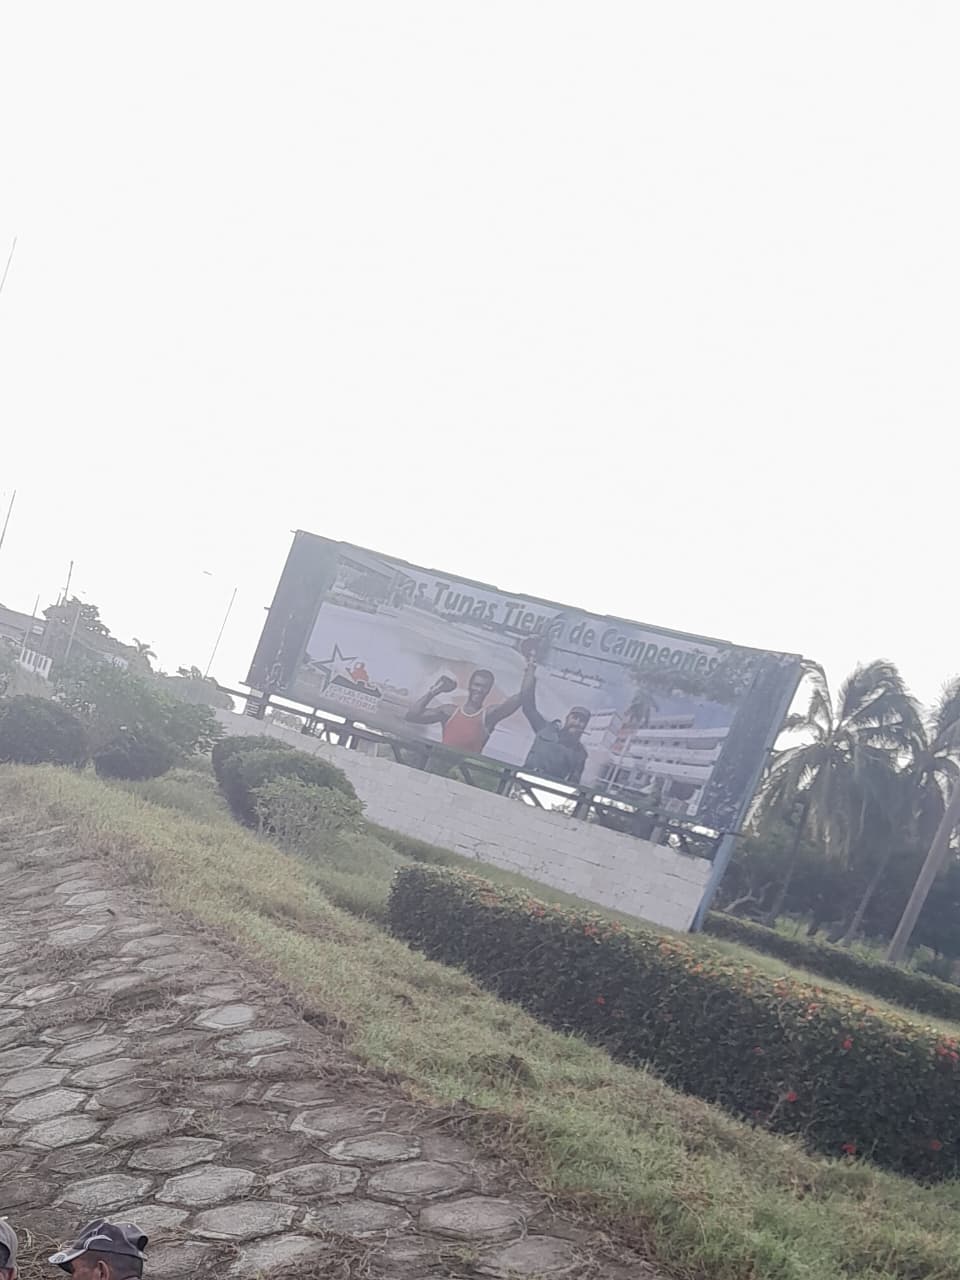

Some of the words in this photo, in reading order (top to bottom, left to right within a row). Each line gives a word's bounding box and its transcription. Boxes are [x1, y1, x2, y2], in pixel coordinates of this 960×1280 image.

[432, 581, 498, 622] Tunas
[500, 601, 566, 639] Tierra
[569, 621, 596, 648] de
[600, 628, 719, 675] Campeones
